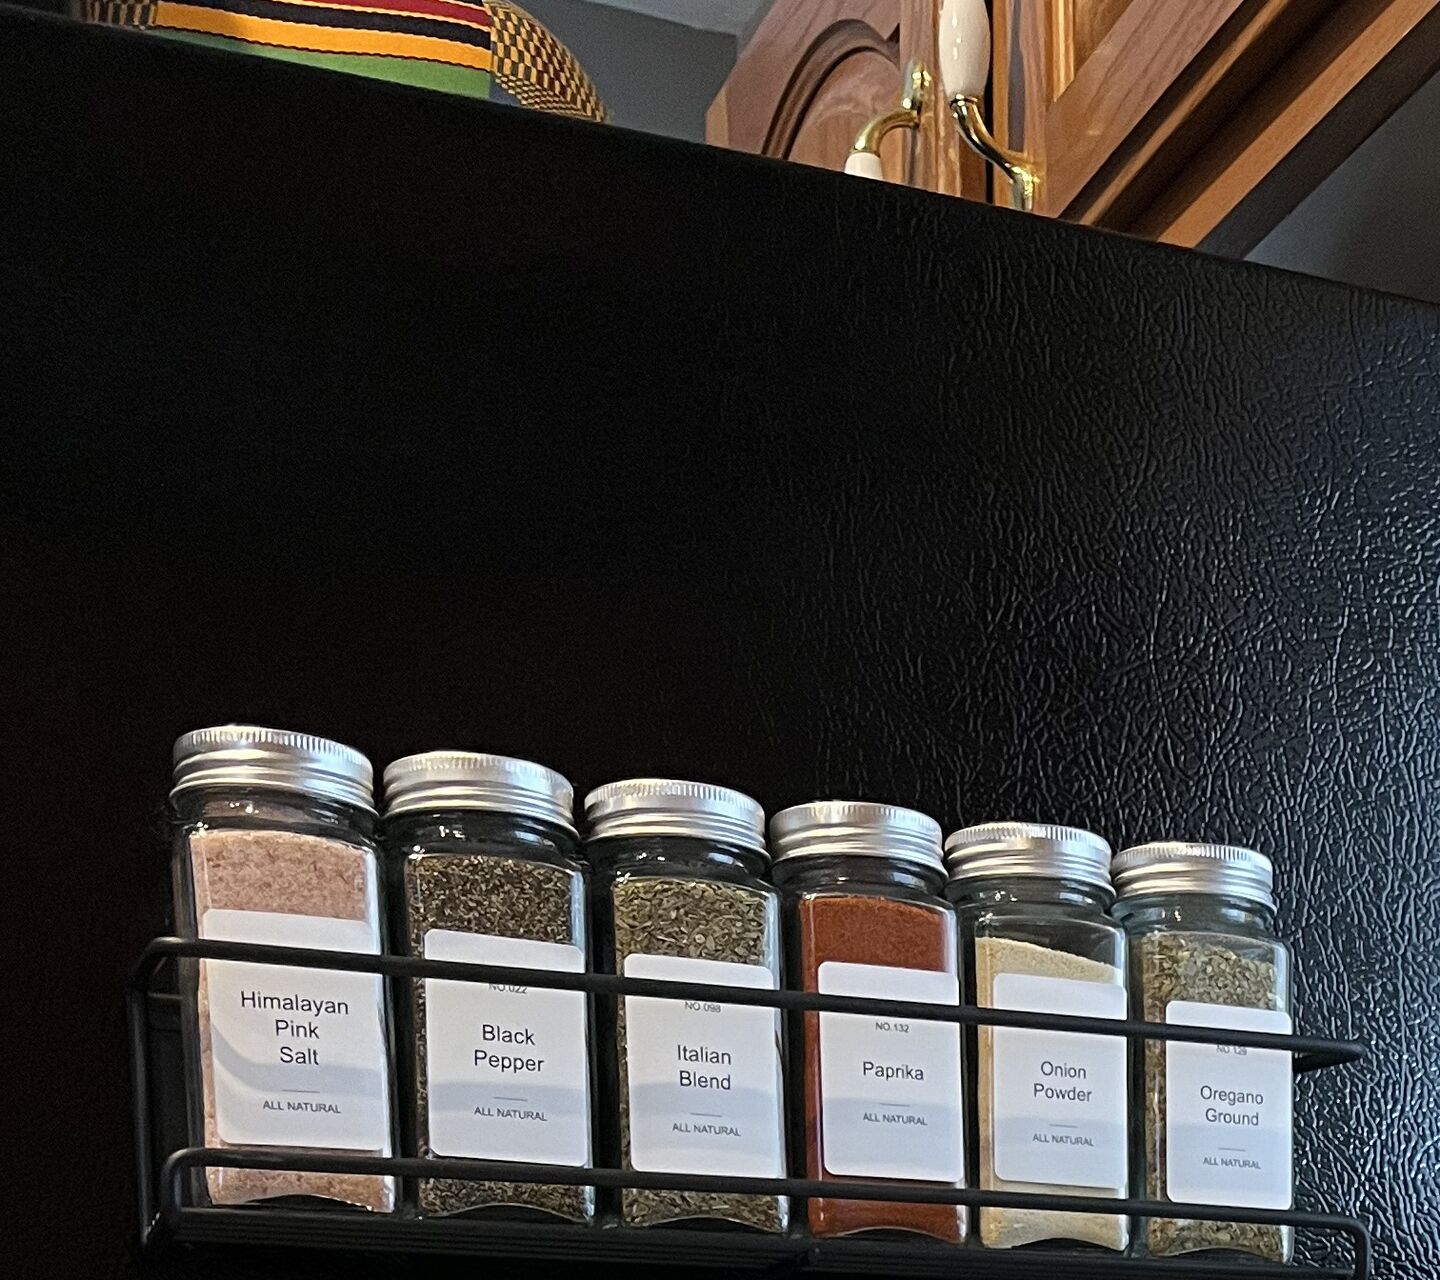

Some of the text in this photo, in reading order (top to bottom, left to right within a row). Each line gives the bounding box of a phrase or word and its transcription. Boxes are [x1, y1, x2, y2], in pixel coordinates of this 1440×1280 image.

[240, 990, 349, 1017] Himalayan
[275, 1019, 320, 1040] Pink
[482, 1024, 536, 1046] Black
[279, 1046, 320, 1066] Salt
[474, 1048, 545, 1074] Pepper
[677, 1044, 732, 1066] Italian
[679, 1069, 731, 1091] Blend
[862, 1061, 924, 1081] Paprika
[1040, 1060, 1087, 1080] Onion
[1033, 1082, 1093, 1102] Powder
[1200, 1085, 1264, 1106] Oregano
[262, 1099, 342, 1114] ALL NATURAL
[473, 1106, 548, 1122] ALL NATURAL
[862, 1111, 928, 1126] ALL NATURAL
[1205, 1107, 1259, 1127] Ground
[672, 1122, 742, 1137] ALL NATURAL
[1032, 1132, 1095, 1147] ALL NATURAL
[1202, 1156, 1262, 1170] ALL NATURAL
